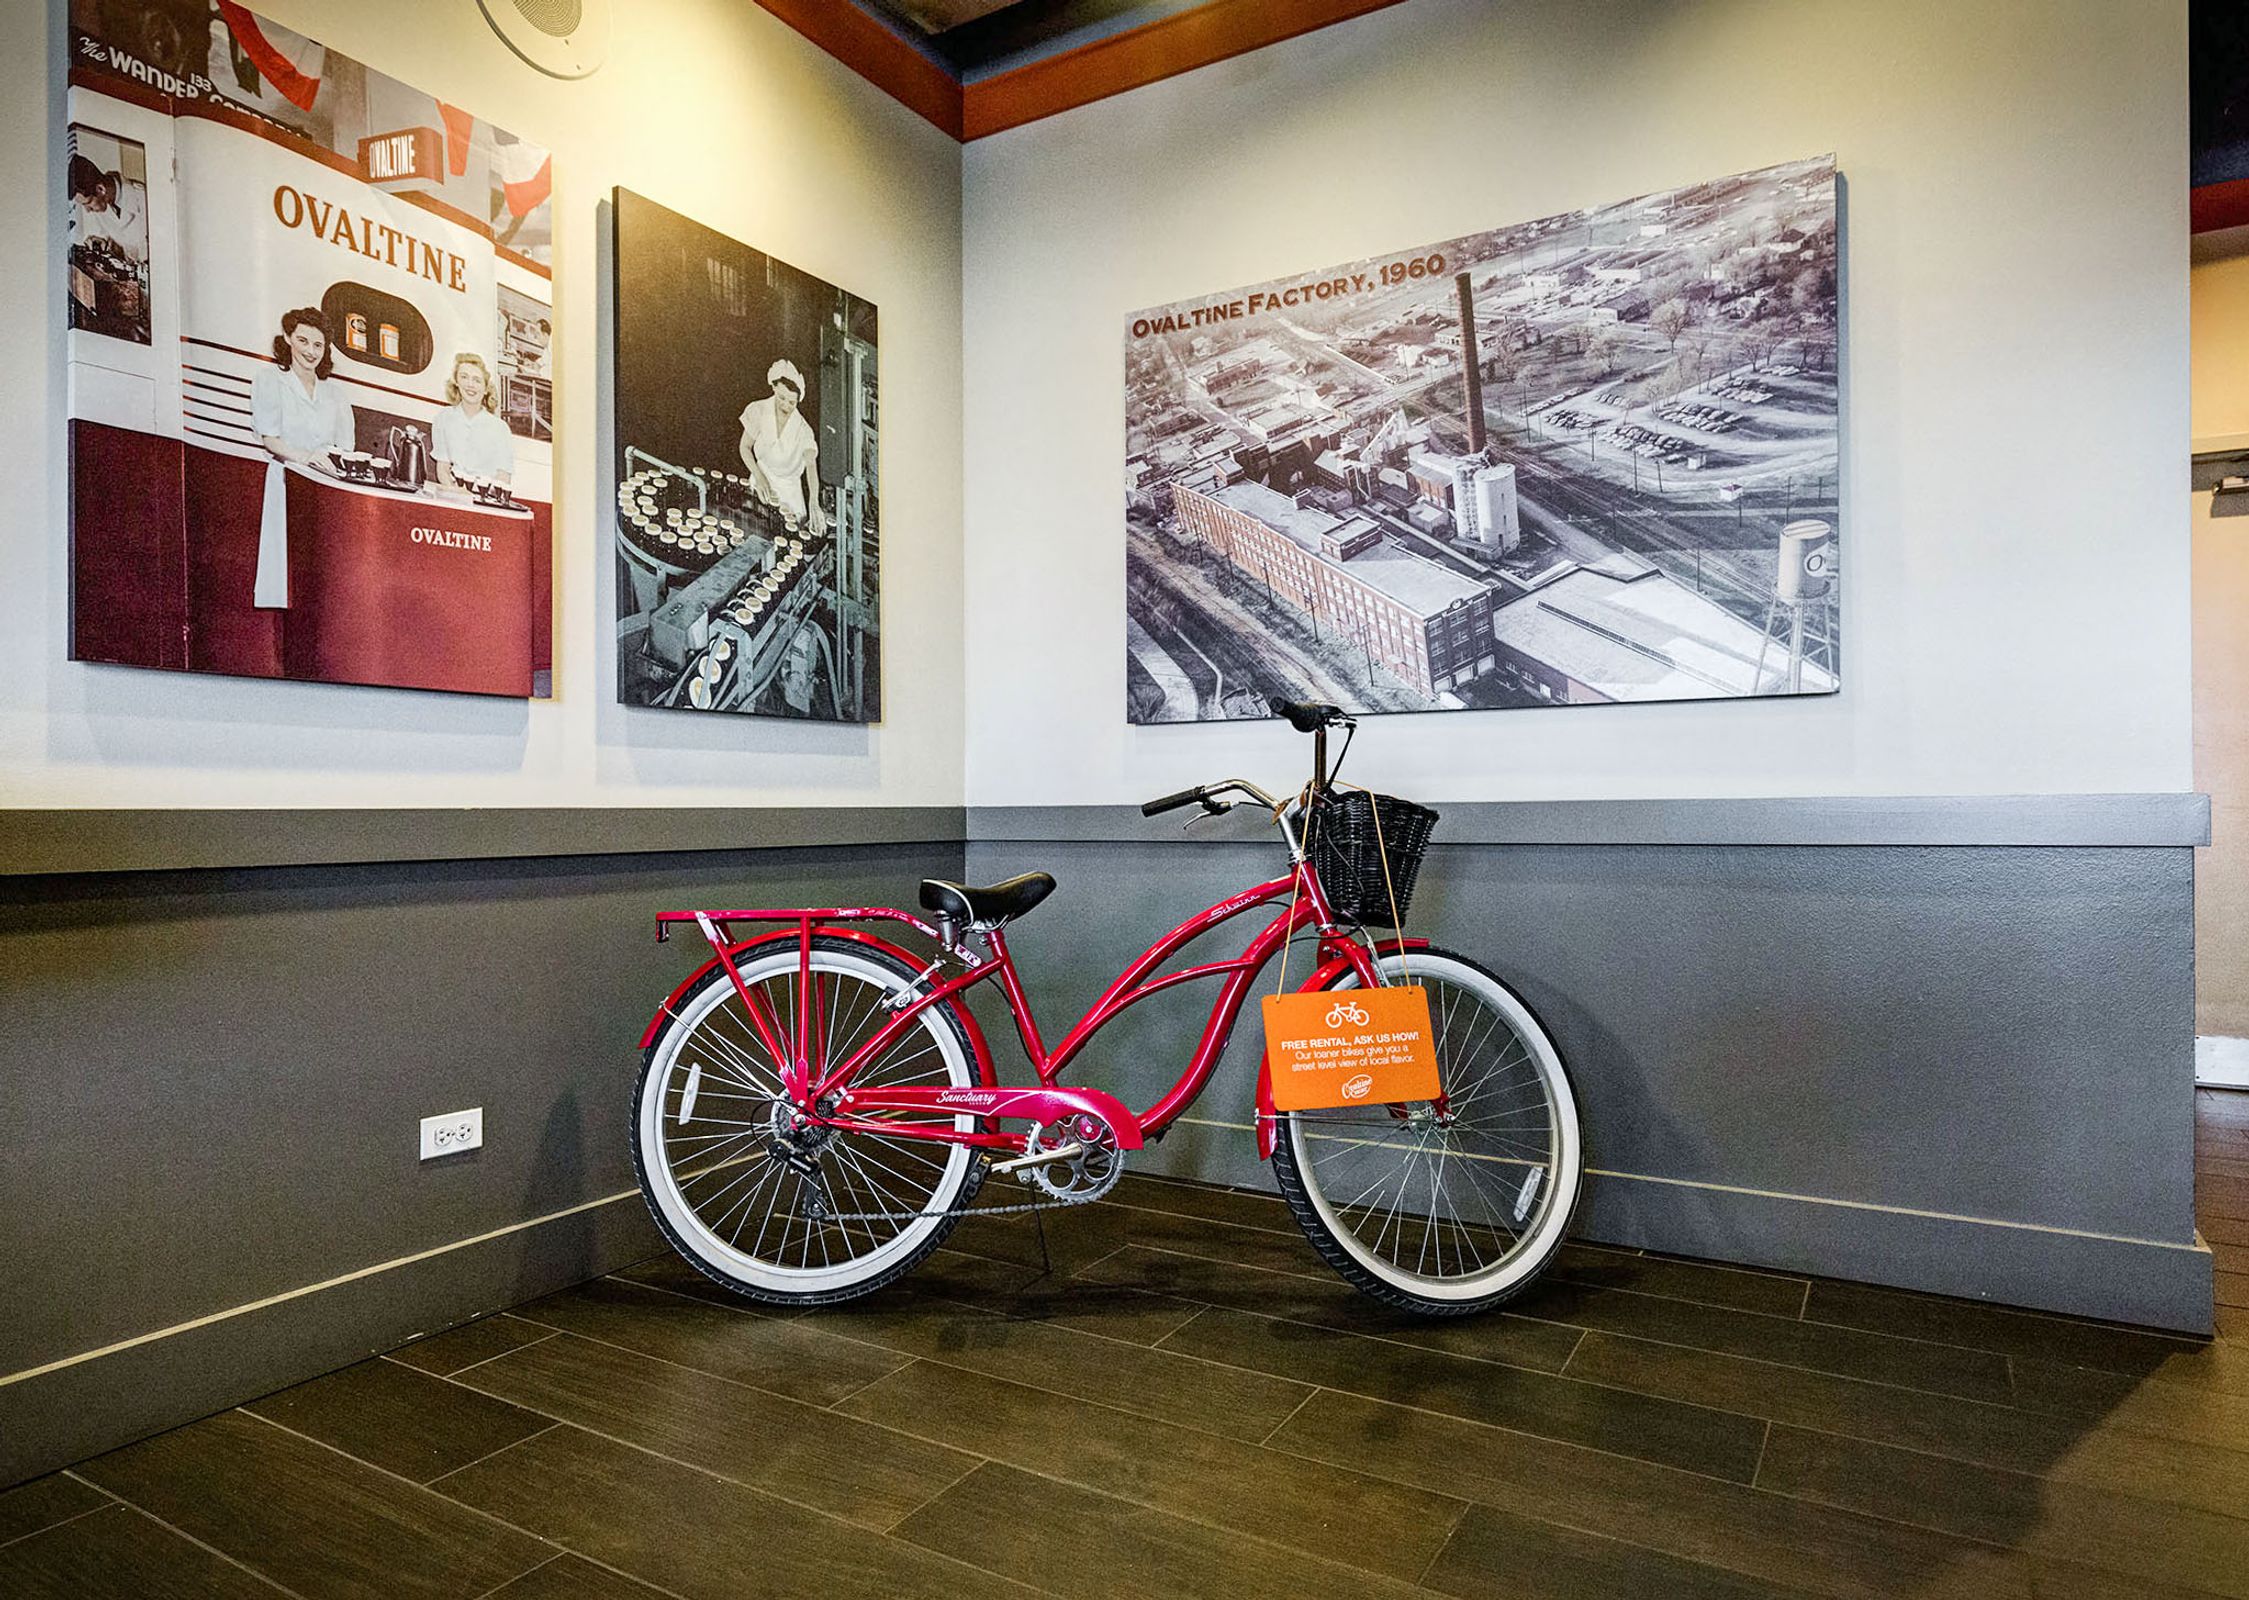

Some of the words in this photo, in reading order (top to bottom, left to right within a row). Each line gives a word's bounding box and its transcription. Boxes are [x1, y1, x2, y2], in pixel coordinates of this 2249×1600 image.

[80, 36, 107, 62] The
[190, 73, 212, 92] 133
[369, 135, 415, 178] OVALTINE
[273, 185, 466, 293] OVALTINE
[1132, 300, 1244, 339] OVALTINE
[1248, 273, 1375, 316] FACTORY,
[1379, 253, 1447, 286] 1960
[410, 527, 492, 552] OVALTINE
[1281, 1040, 1308, 1050] FREE
[1310, 1037, 1352, 1048] RENTAL,
[1354, 1035, 1375, 1045] ASK
[1376, 1033, 1390, 1043] US
[1392, 1031, 1419, 1041] HOW!
[1295, 1051, 1311, 1060] Our
[1314, 1049, 1340, 1059] loaner
[1342, 1047, 1364, 1056] bikes
[1366, 1045, 1383, 1057] give
[1385, 1045, 1401, 1055] you
[1402, 1044, 1409, 1052] a
[1292, 1062, 1316, 1072] street
[1318, 1060, 1337, 1070] level
[1338, 1058, 1358, 1068] view
[1360, 1057, 1368, 1066] of
[1369, 1056, 1389, 1065] local
[1391, 1055, 1415, 1064] flavor.
[936, 1090, 997, 1105] Sanctuary
